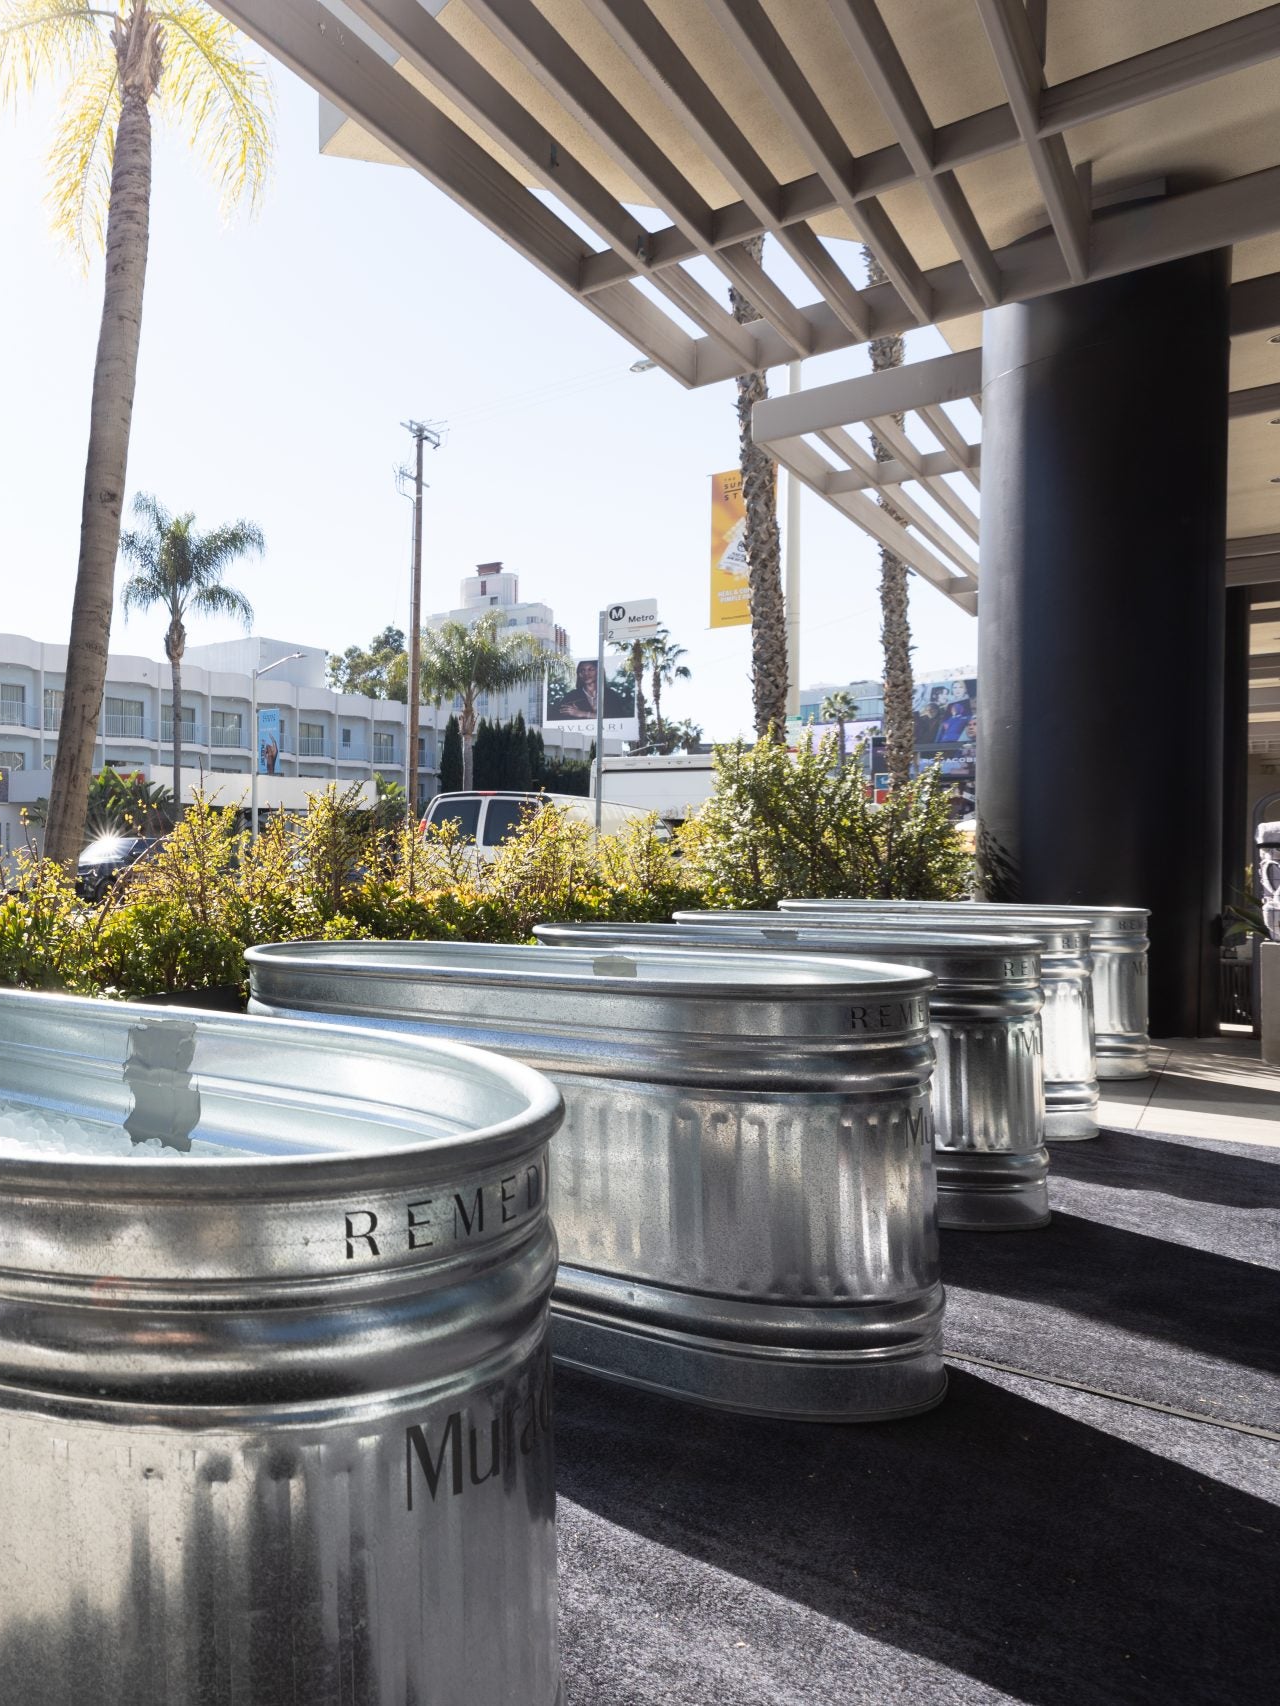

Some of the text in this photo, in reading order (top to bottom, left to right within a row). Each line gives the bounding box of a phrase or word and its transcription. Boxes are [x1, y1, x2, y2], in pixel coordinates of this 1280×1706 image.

[628, 614, 654, 623] Metro
[608, 630, 614, 638] 2
[558, 723, 624, 732] BVLGRI
[345, 1152, 548, 1260] REMED
